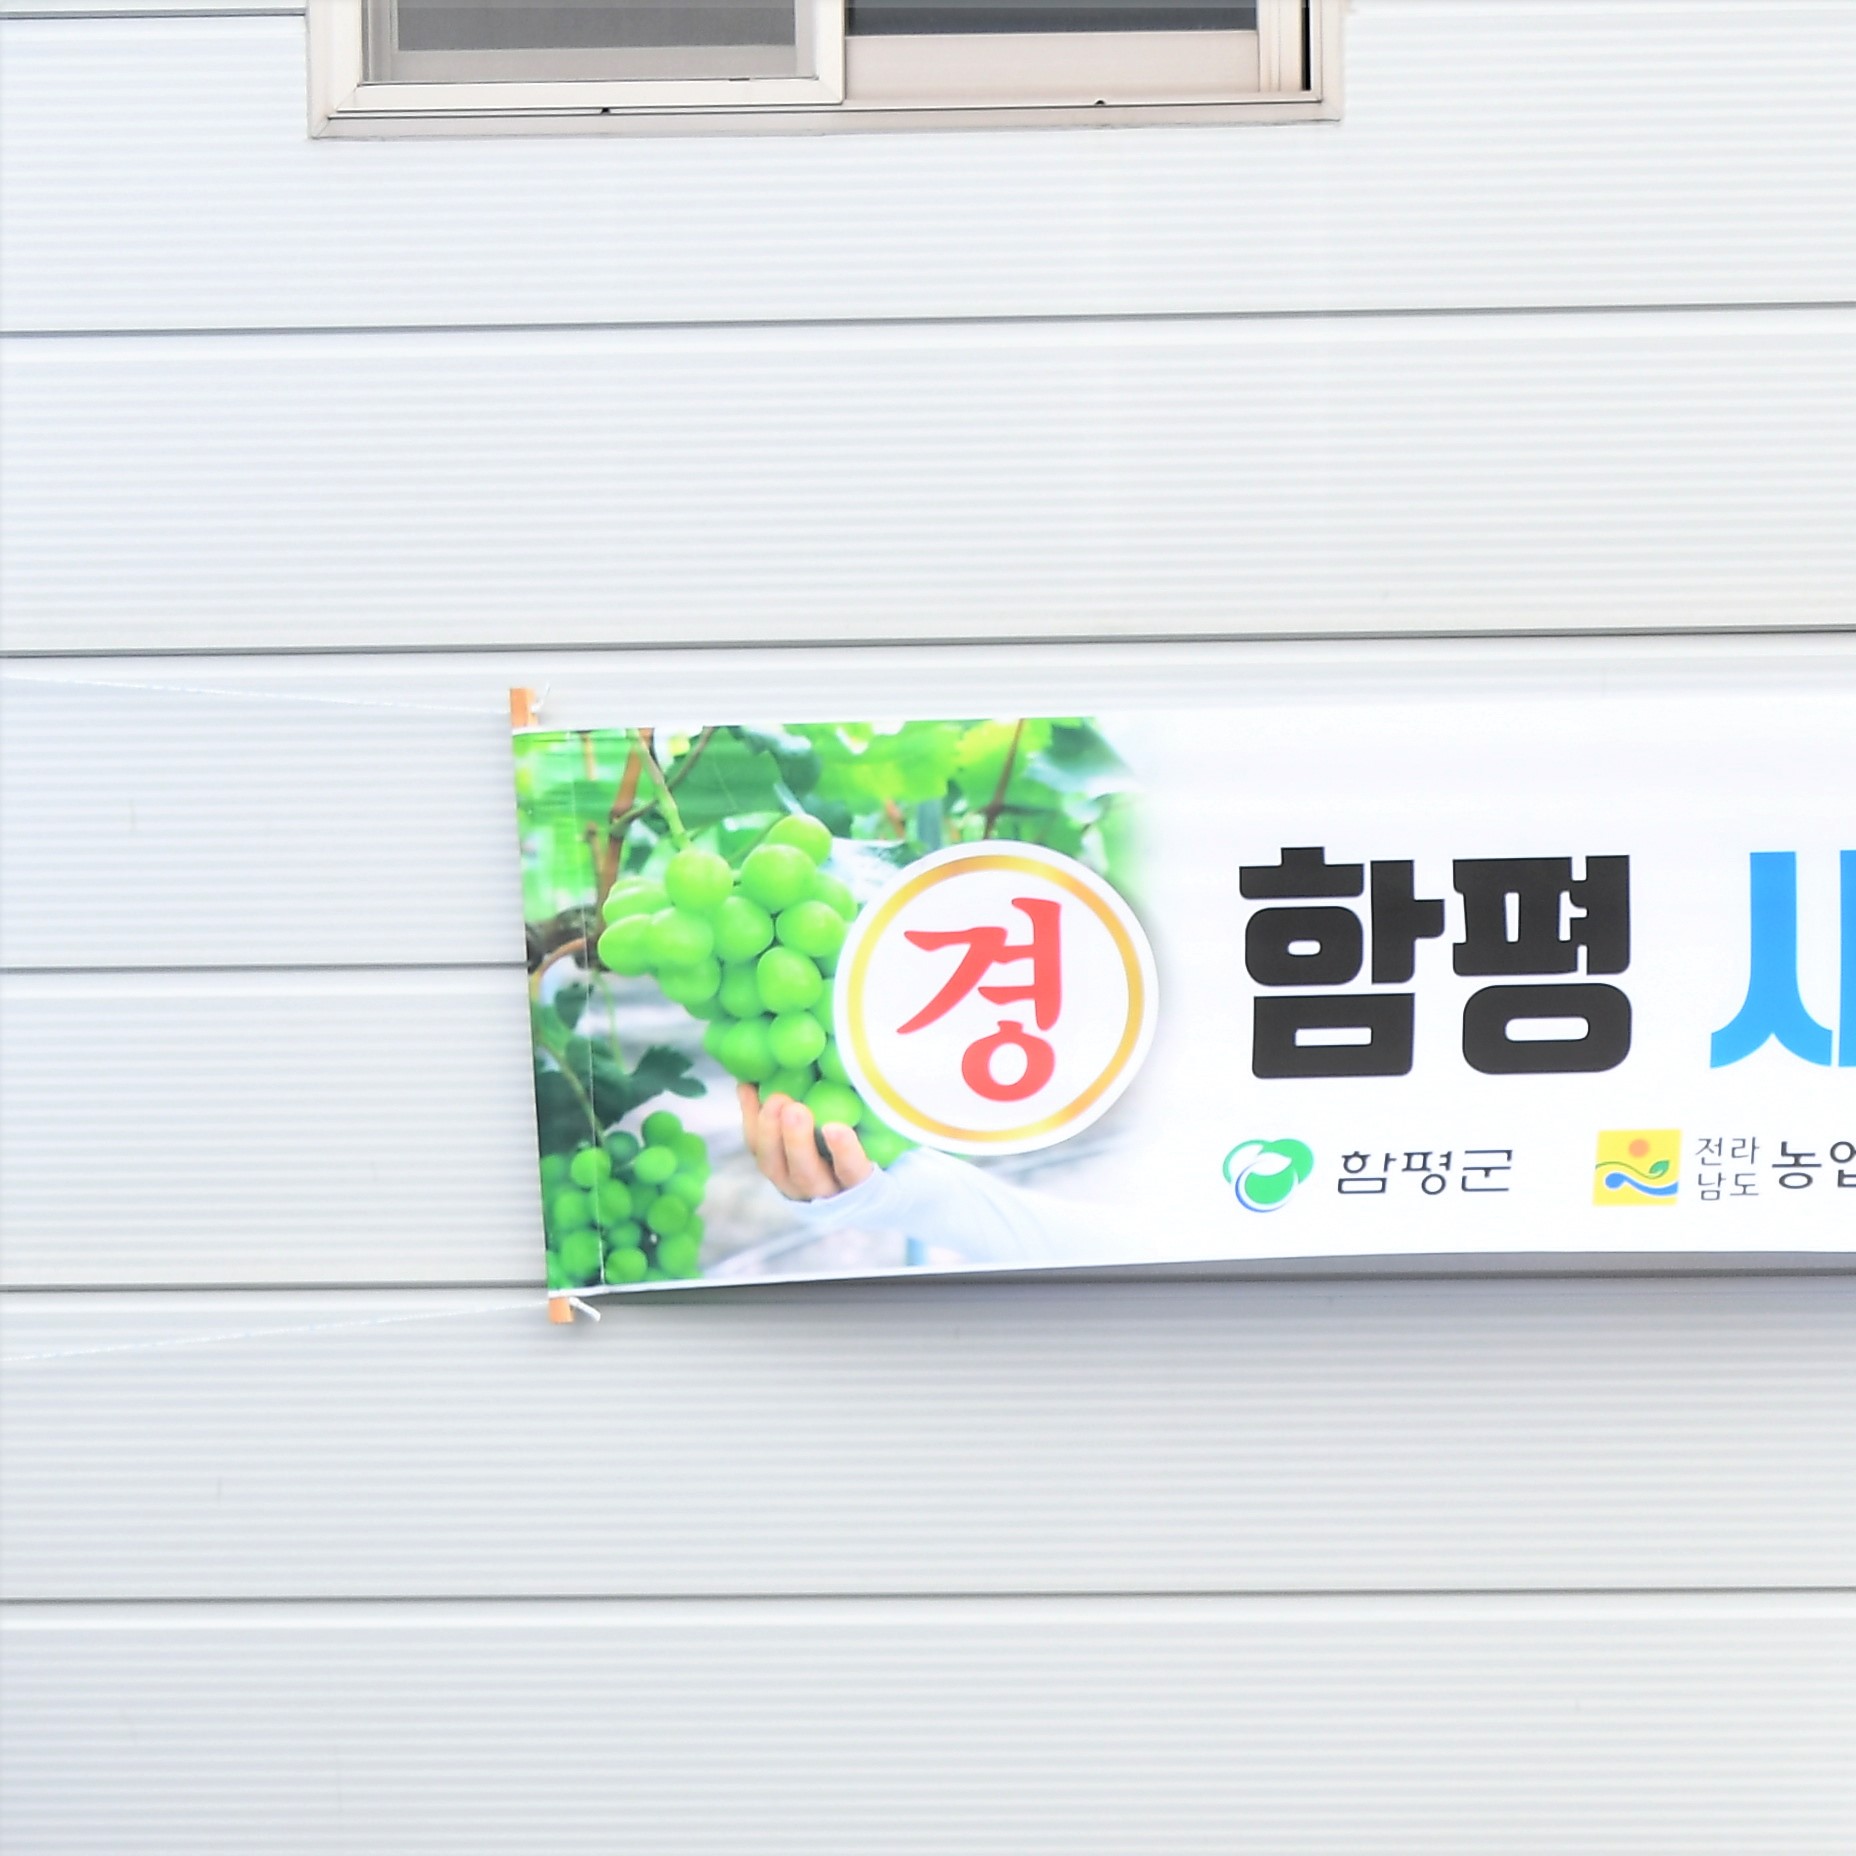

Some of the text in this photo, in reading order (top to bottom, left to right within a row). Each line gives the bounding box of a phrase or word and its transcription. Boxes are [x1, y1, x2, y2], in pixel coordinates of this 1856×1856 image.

[1239, 846, 1632, 1079] 함평
[898, 898, 1061, 1101] 경
[1337, 1149, 1513, 1196] 함평군
[1696, 1136, 1760, 1167] 전라
[1696, 1171, 1760, 1202] 남도
